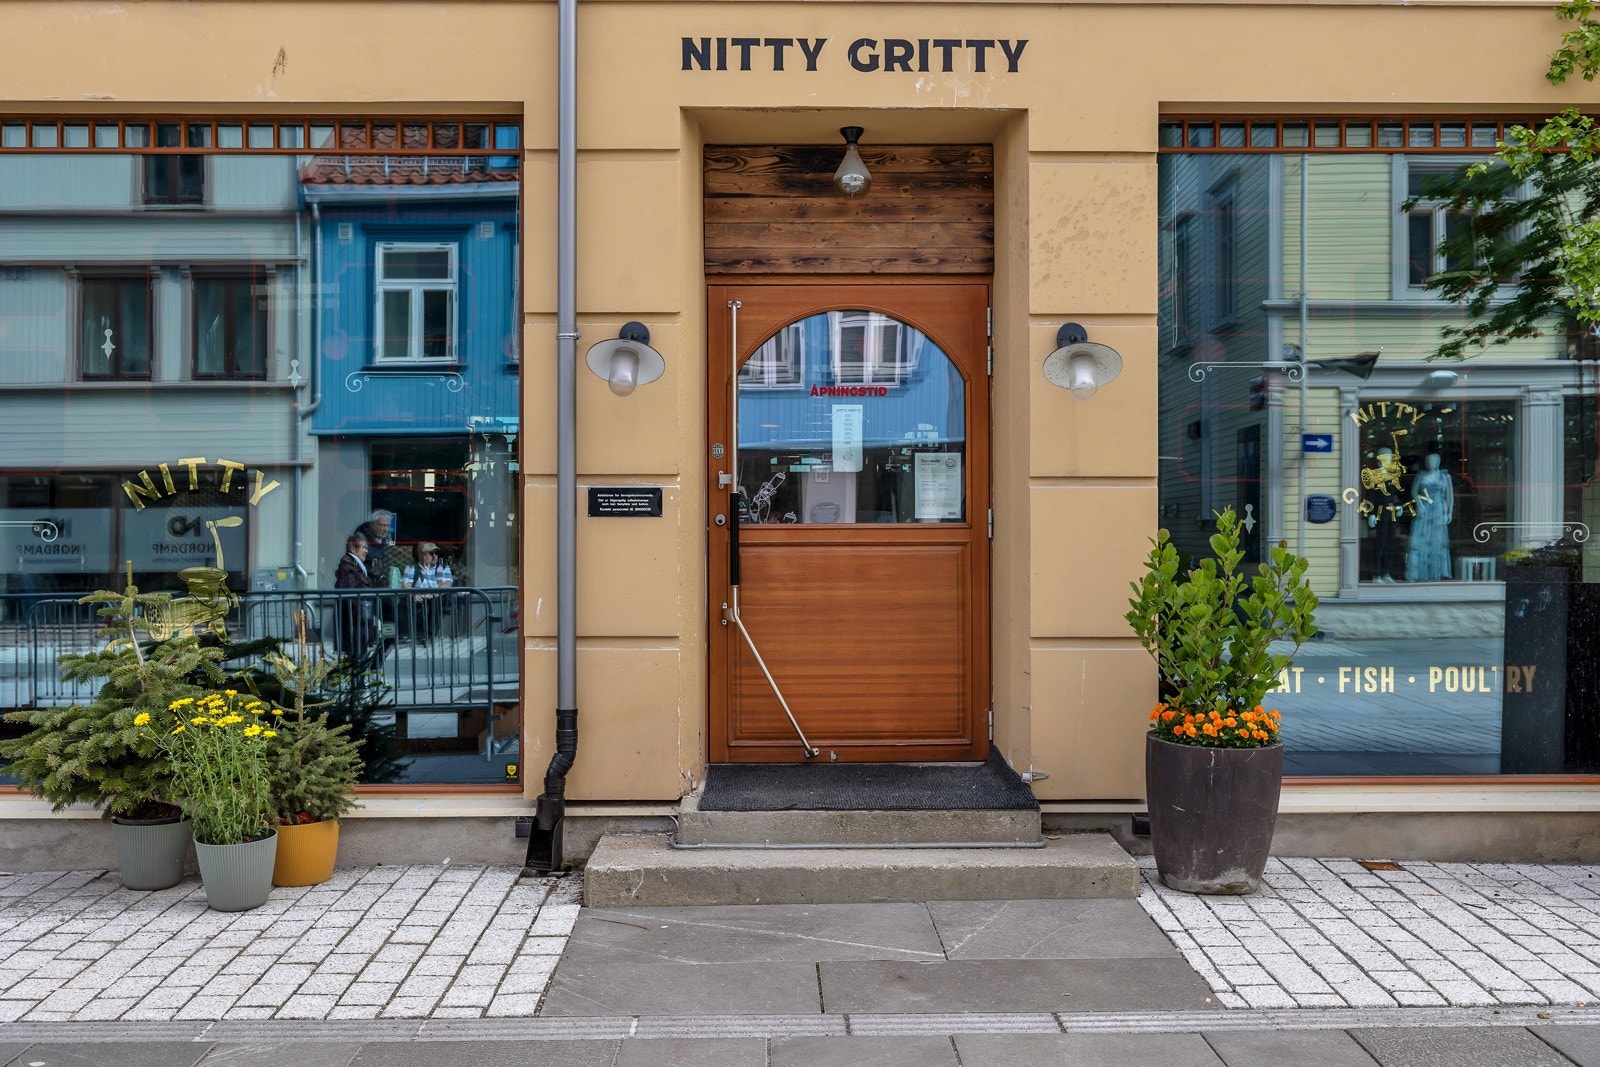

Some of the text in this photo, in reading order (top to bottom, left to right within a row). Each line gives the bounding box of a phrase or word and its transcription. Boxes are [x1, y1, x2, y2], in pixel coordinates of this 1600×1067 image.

[681, 37, 1030, 73] NITTY GRITTY
[810, 384, 888, 397] ÅPNINGSTID
[1350, 400, 1426, 428] NITTY
[121, 457, 281, 512] NITTY
[1342, 487, 1433, 522] GRITTY
[1339, 667, 1395, 693] FISH
